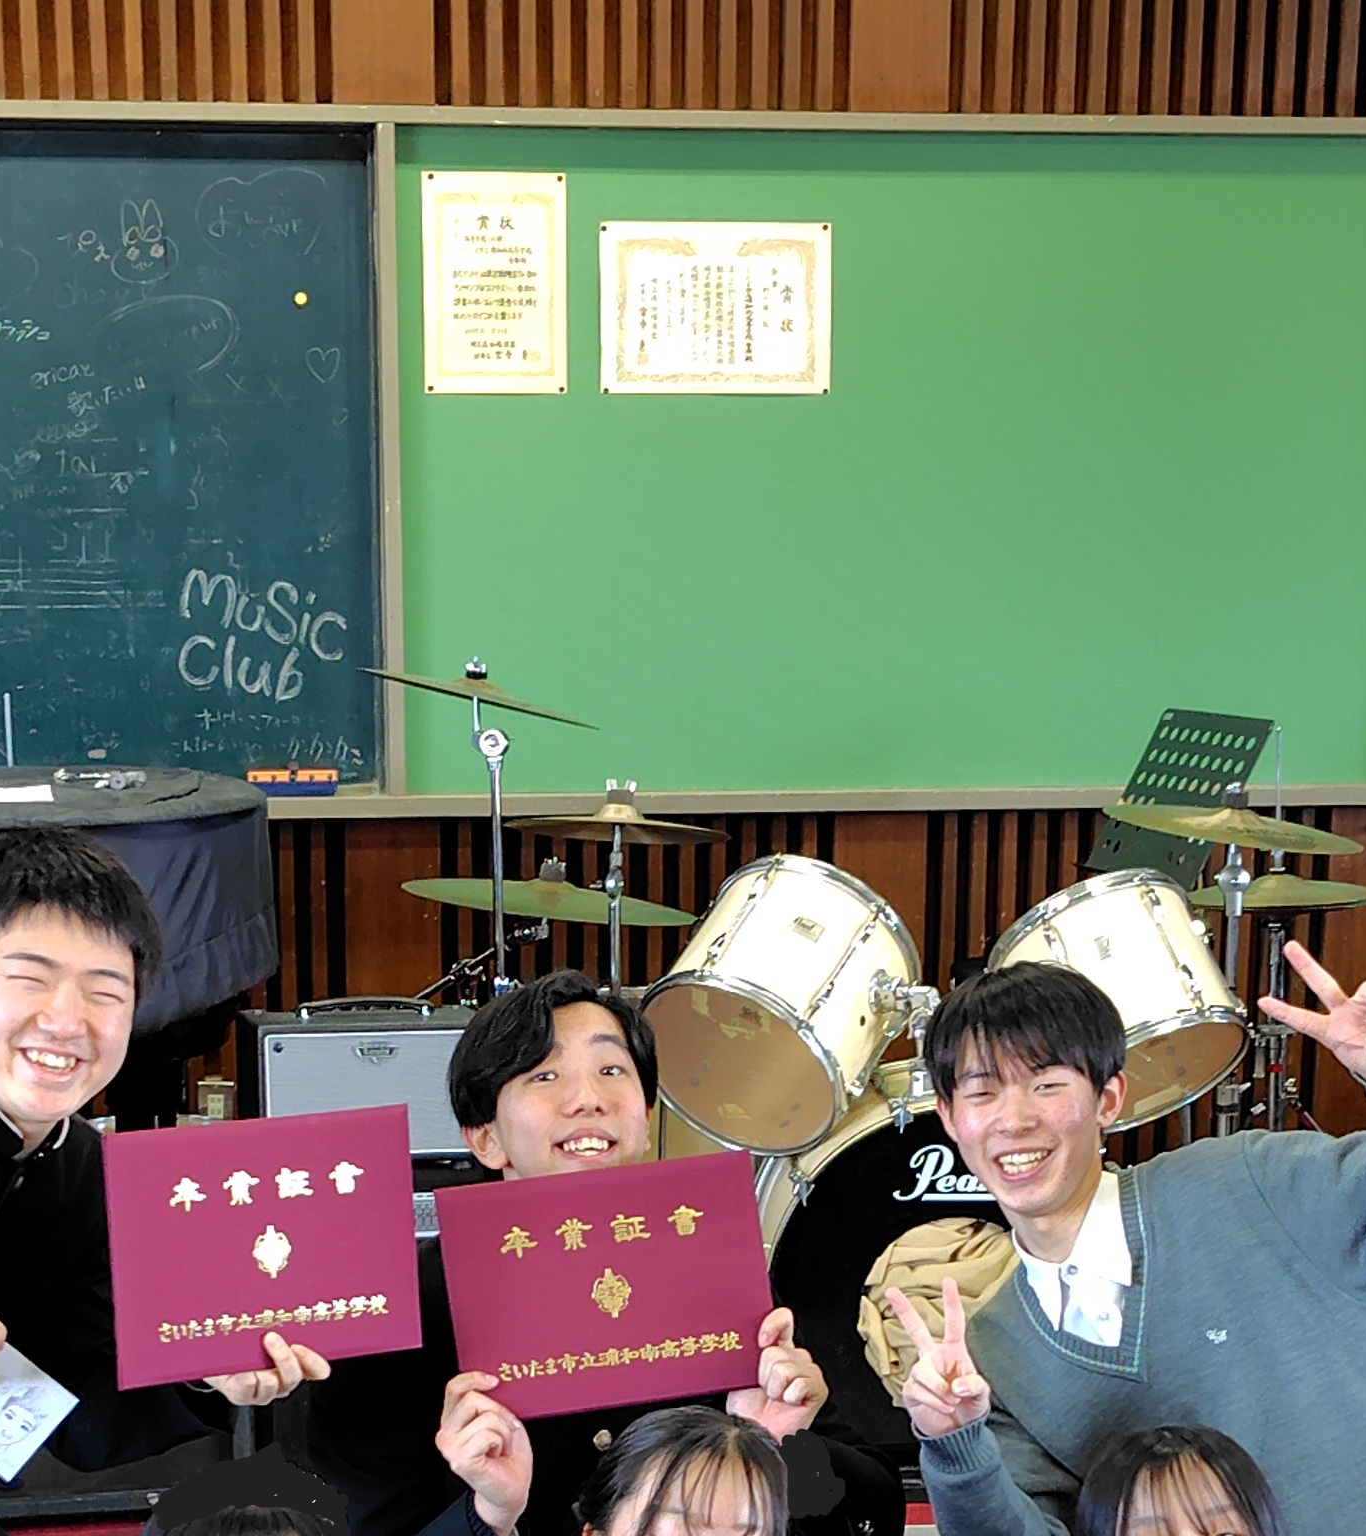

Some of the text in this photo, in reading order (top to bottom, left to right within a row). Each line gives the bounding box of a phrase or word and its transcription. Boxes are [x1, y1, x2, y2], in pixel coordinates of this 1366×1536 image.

[179, 634, 304, 702] Club
[892, 1143, 988, 1201] Pea
[501, 1204, 704, 1259] 卒業証書
